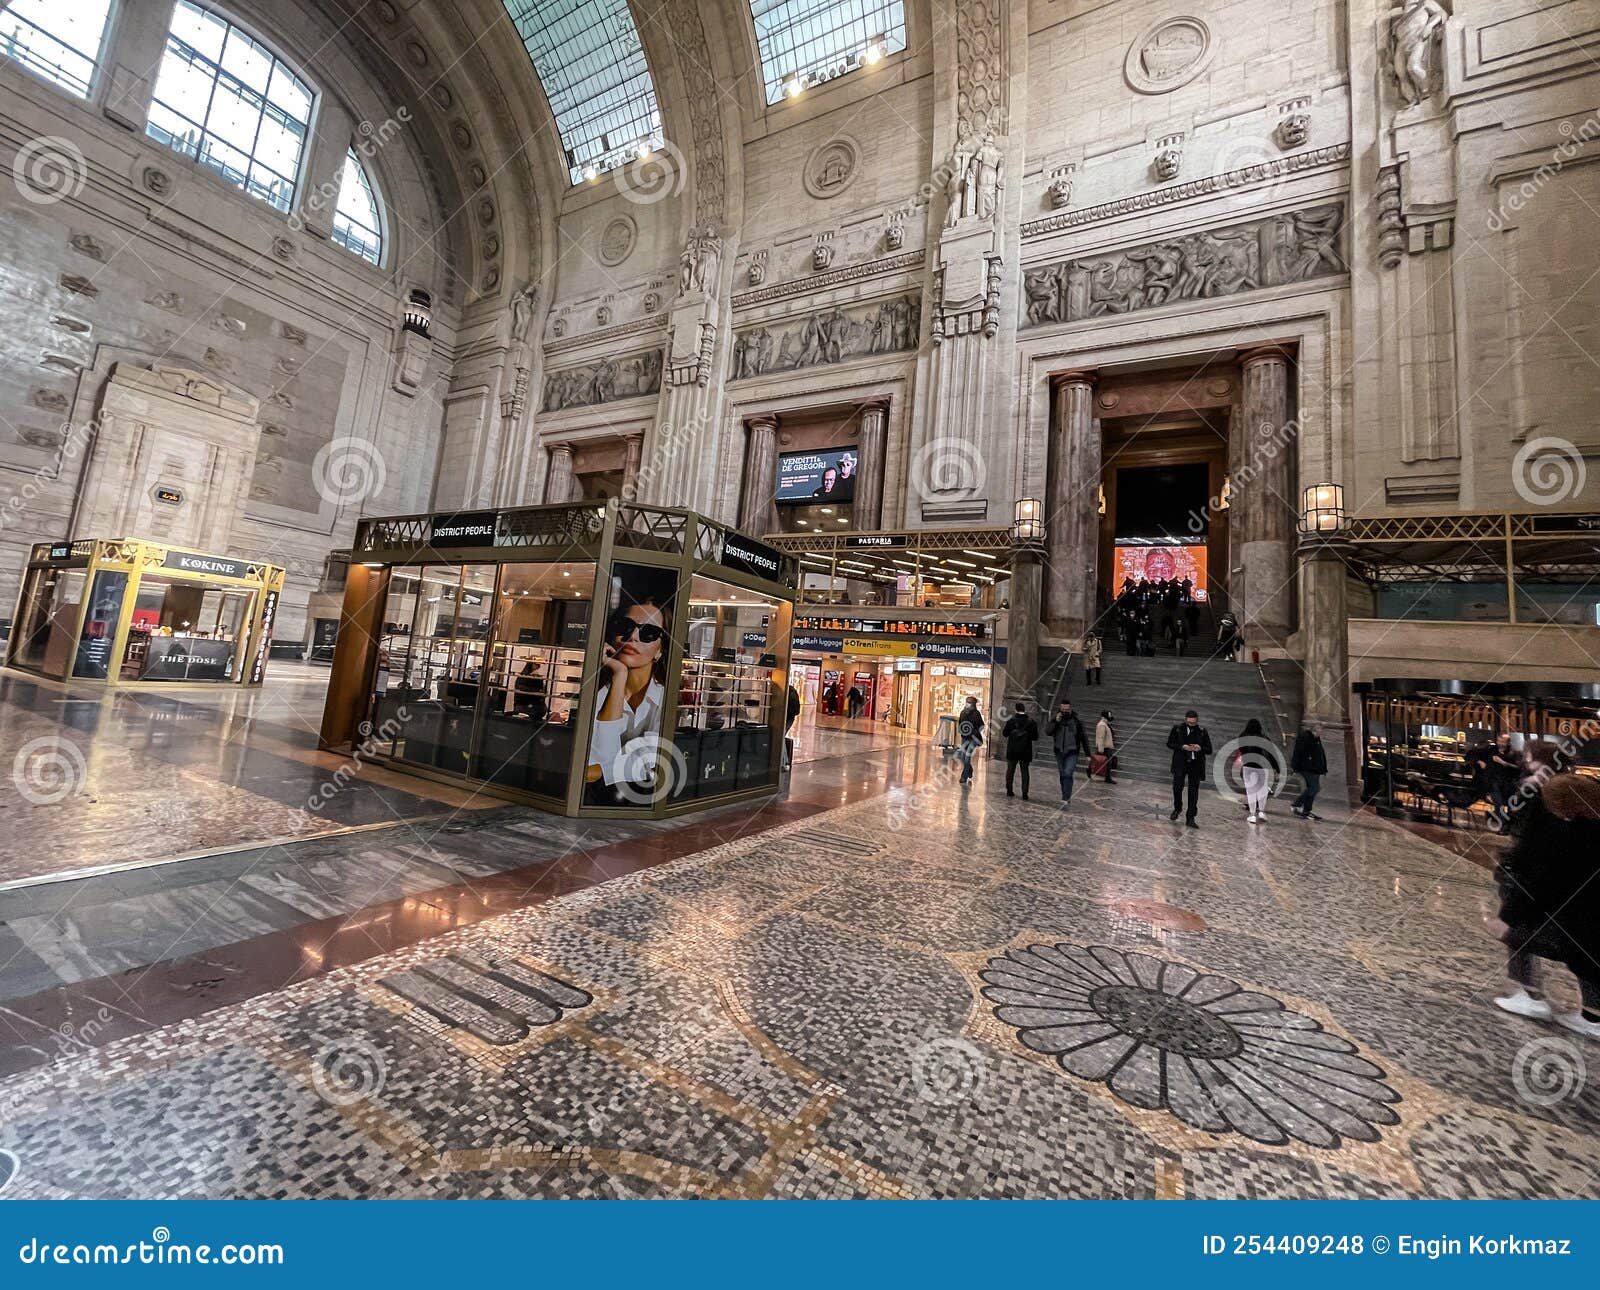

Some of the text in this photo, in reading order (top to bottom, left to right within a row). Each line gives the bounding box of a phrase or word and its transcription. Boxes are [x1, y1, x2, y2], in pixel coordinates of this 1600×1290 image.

[782, 456, 817, 465] VENDITTI
[793, 461, 826, 471] GREGORI
[434, 525, 492, 537] DISTRICT PEOPLE
[858, 537, 892, 545] PASTARIA
[725, 544, 777, 571] DISTRICT PEOPLE
[180, 557, 236, 573] KOKINE
[932, 643, 987, 655] Biglietti Tickets
[159, 655, 217, 665] THE DOSE
